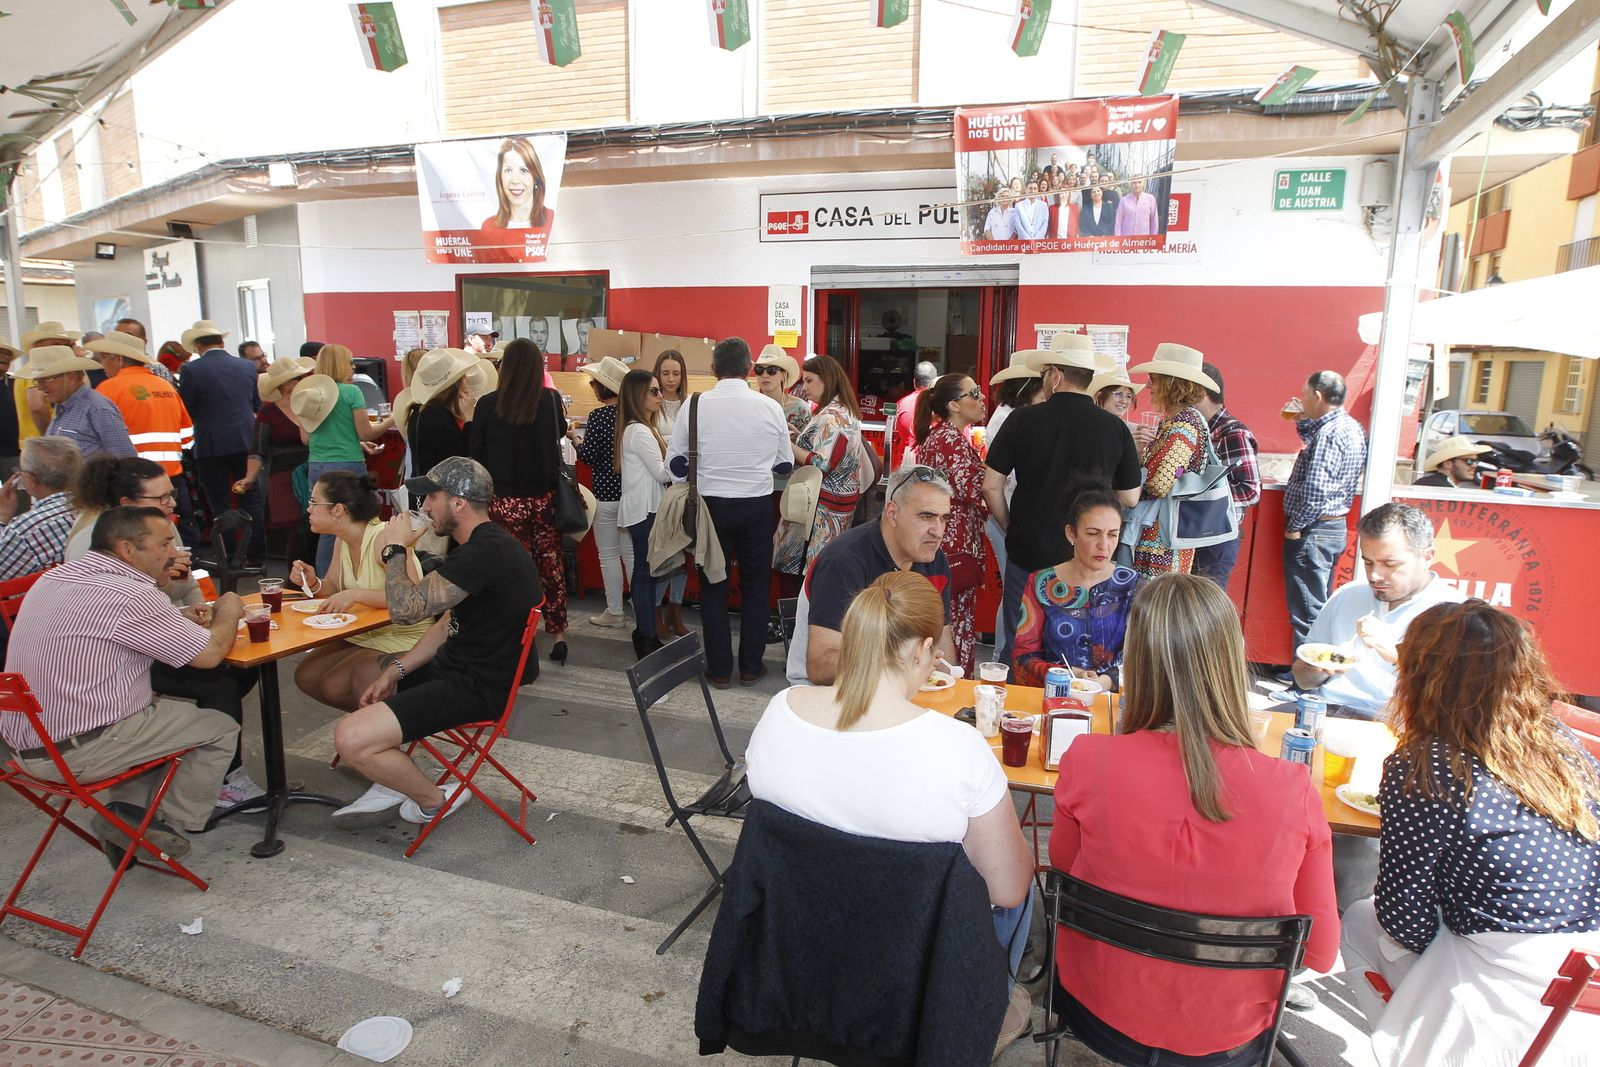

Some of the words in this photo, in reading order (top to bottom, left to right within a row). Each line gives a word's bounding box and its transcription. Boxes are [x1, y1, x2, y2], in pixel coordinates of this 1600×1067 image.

[968, 113, 1026, 130] HUÉRCAL
[1107, 119, 1143, 136] PSOE
[968, 129, 989, 139] nos
[993, 127, 1025, 142] UNE
[1300, 172, 1332, 183] CALLE
[1295, 185, 1322, 197] JUAN
[1279, 198, 1292, 208] DE
[1294, 197, 1337, 208] AUSTRIA
[768, 223, 788, 231] PSOE
[814, 206, 874, 228] CASA
[884, 212, 912, 226] DEL
[435, 233, 472, 247] HUÉRCAL
[969, 242, 1019, 253] Candidatura
[1020, 241, 1035, 252] del
[1035, 240, 1059, 251] PSOE
[1061, 240, 1073, 250] de
[1074, 238, 1108, 250] Huércal
[1109, 238, 1120, 248] de
[1122, 237, 1157, 248] Almería
[453, 247, 473, 258] UNE
[525, 245, 545, 257] PSOE
[774, 301, 790, 310] CASA
[774, 310, 785, 318] DEL
[774, 318, 797, 327] PUEBLO
[1419, 499, 1541, 572] MEDITERRÁNEA
[1525, 581, 1544, 613] 1876
